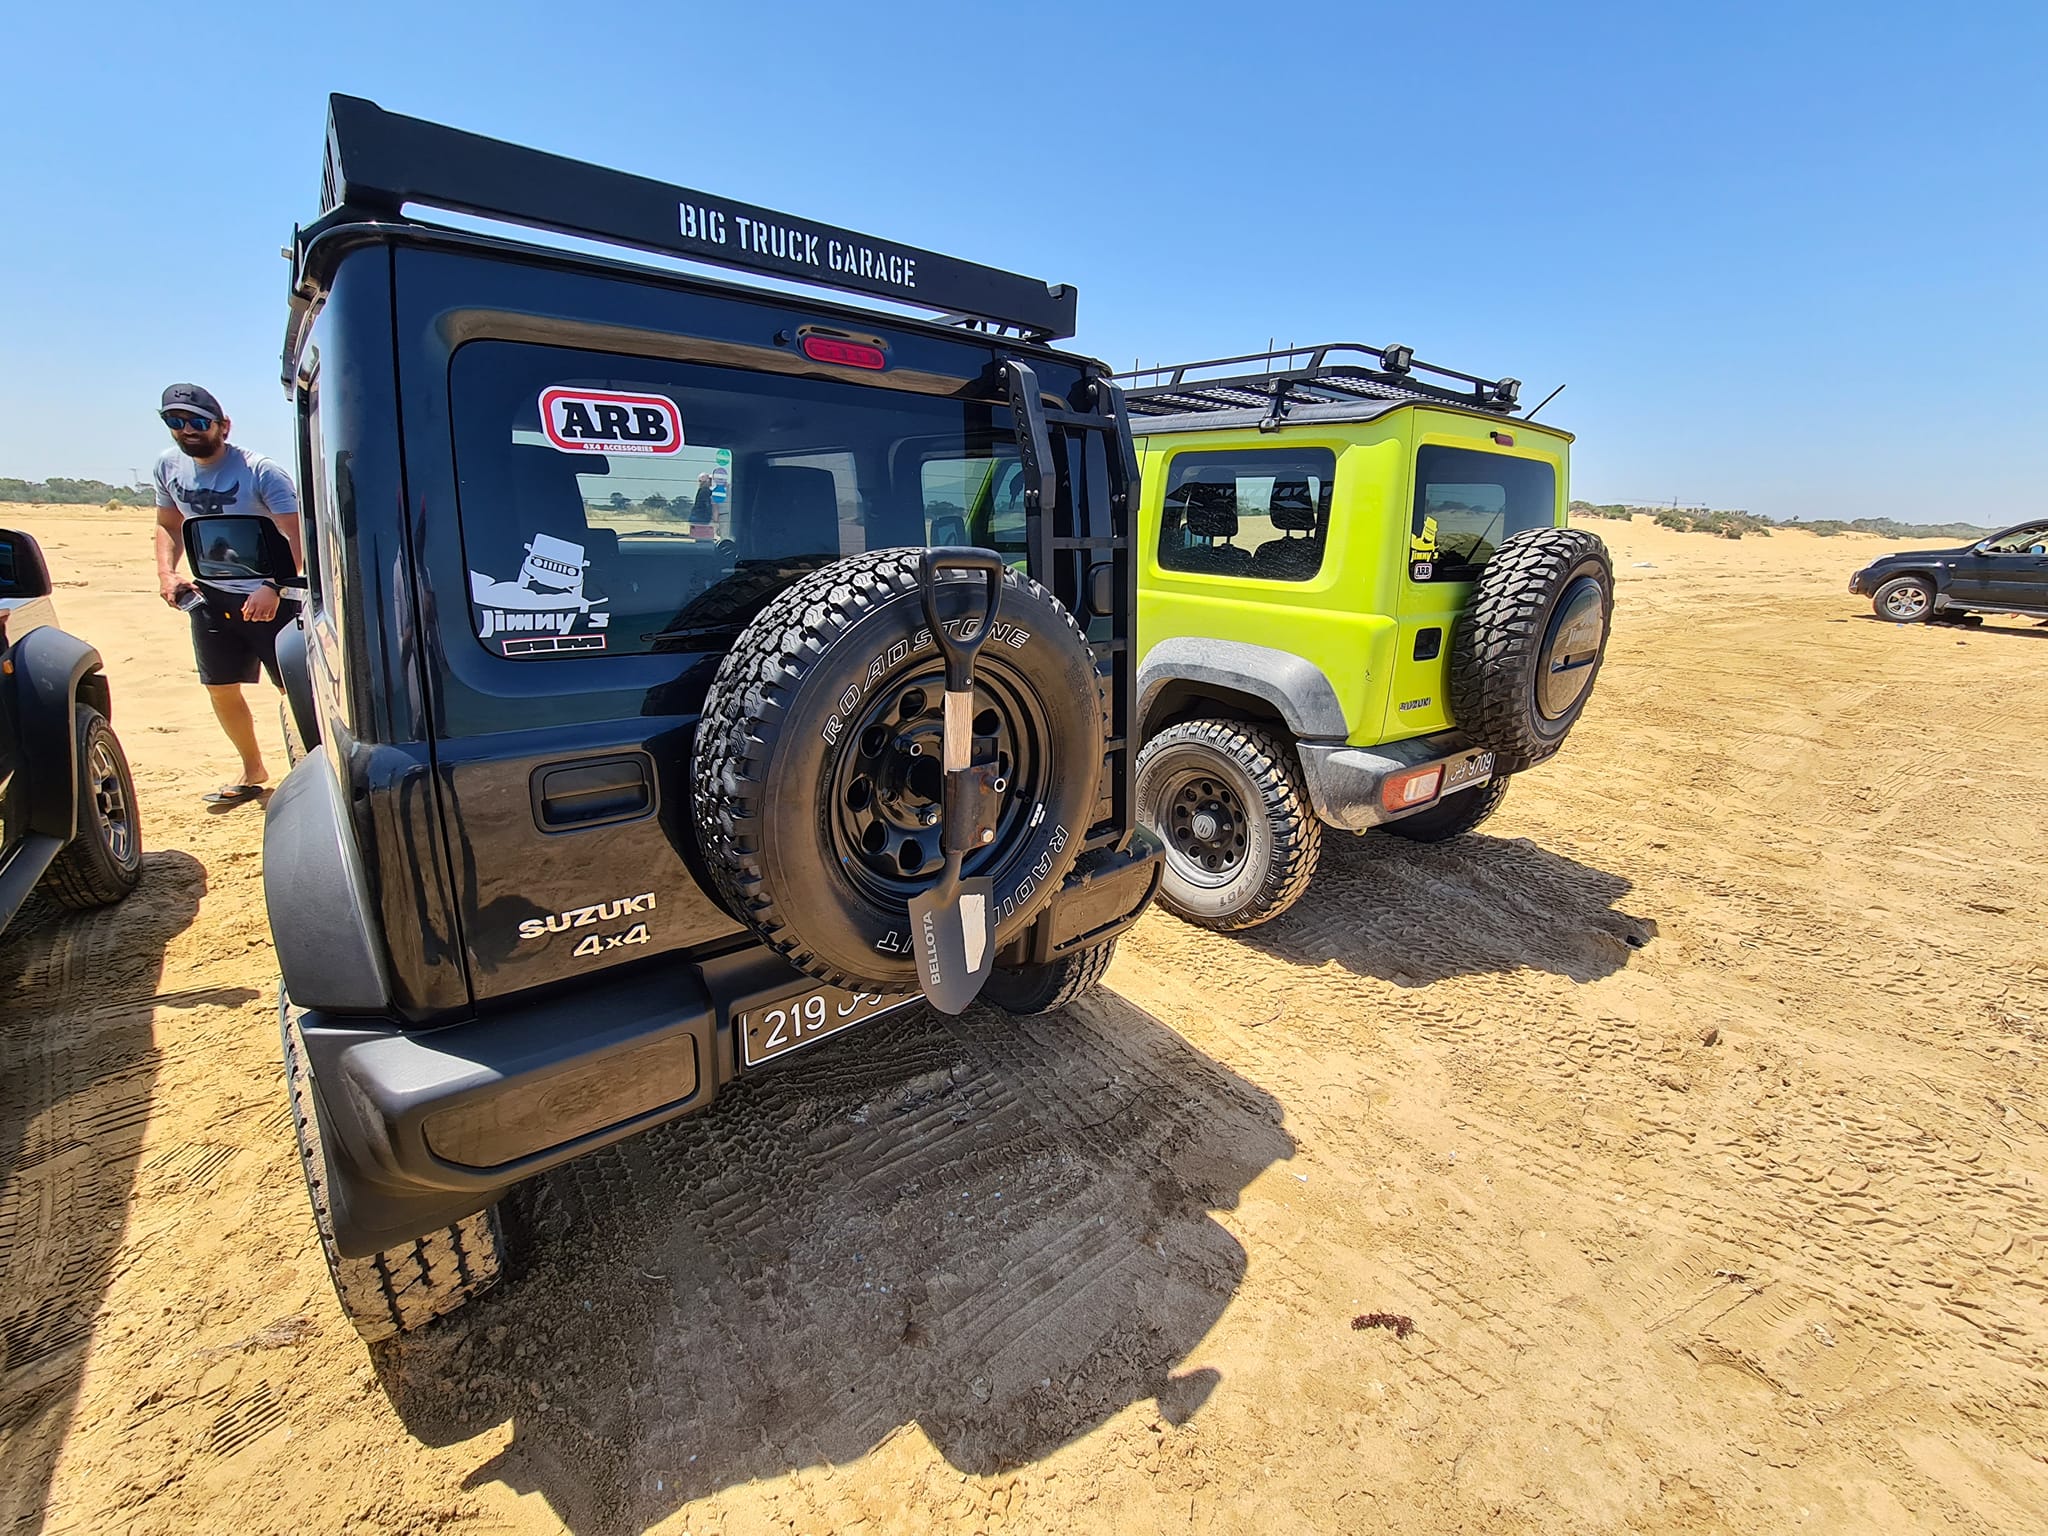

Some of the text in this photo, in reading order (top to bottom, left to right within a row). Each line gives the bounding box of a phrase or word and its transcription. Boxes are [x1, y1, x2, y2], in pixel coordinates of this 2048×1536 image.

[679, 202, 917, 288] BIG TRUCK GARAGE
[560, 400, 669, 442] ARB
[603, 443, 654, 453] ACCESSORIES
[822, 618, 1031, 746] ROADSTONE
[1397, 696, 1432, 712] SUZUKI
[518, 891, 657, 940] SUZUKI
[573, 924, 651, 958] 4x4
[921, 909, 943, 987] BELLOTA
[763, 995, 827, 1050] 219
